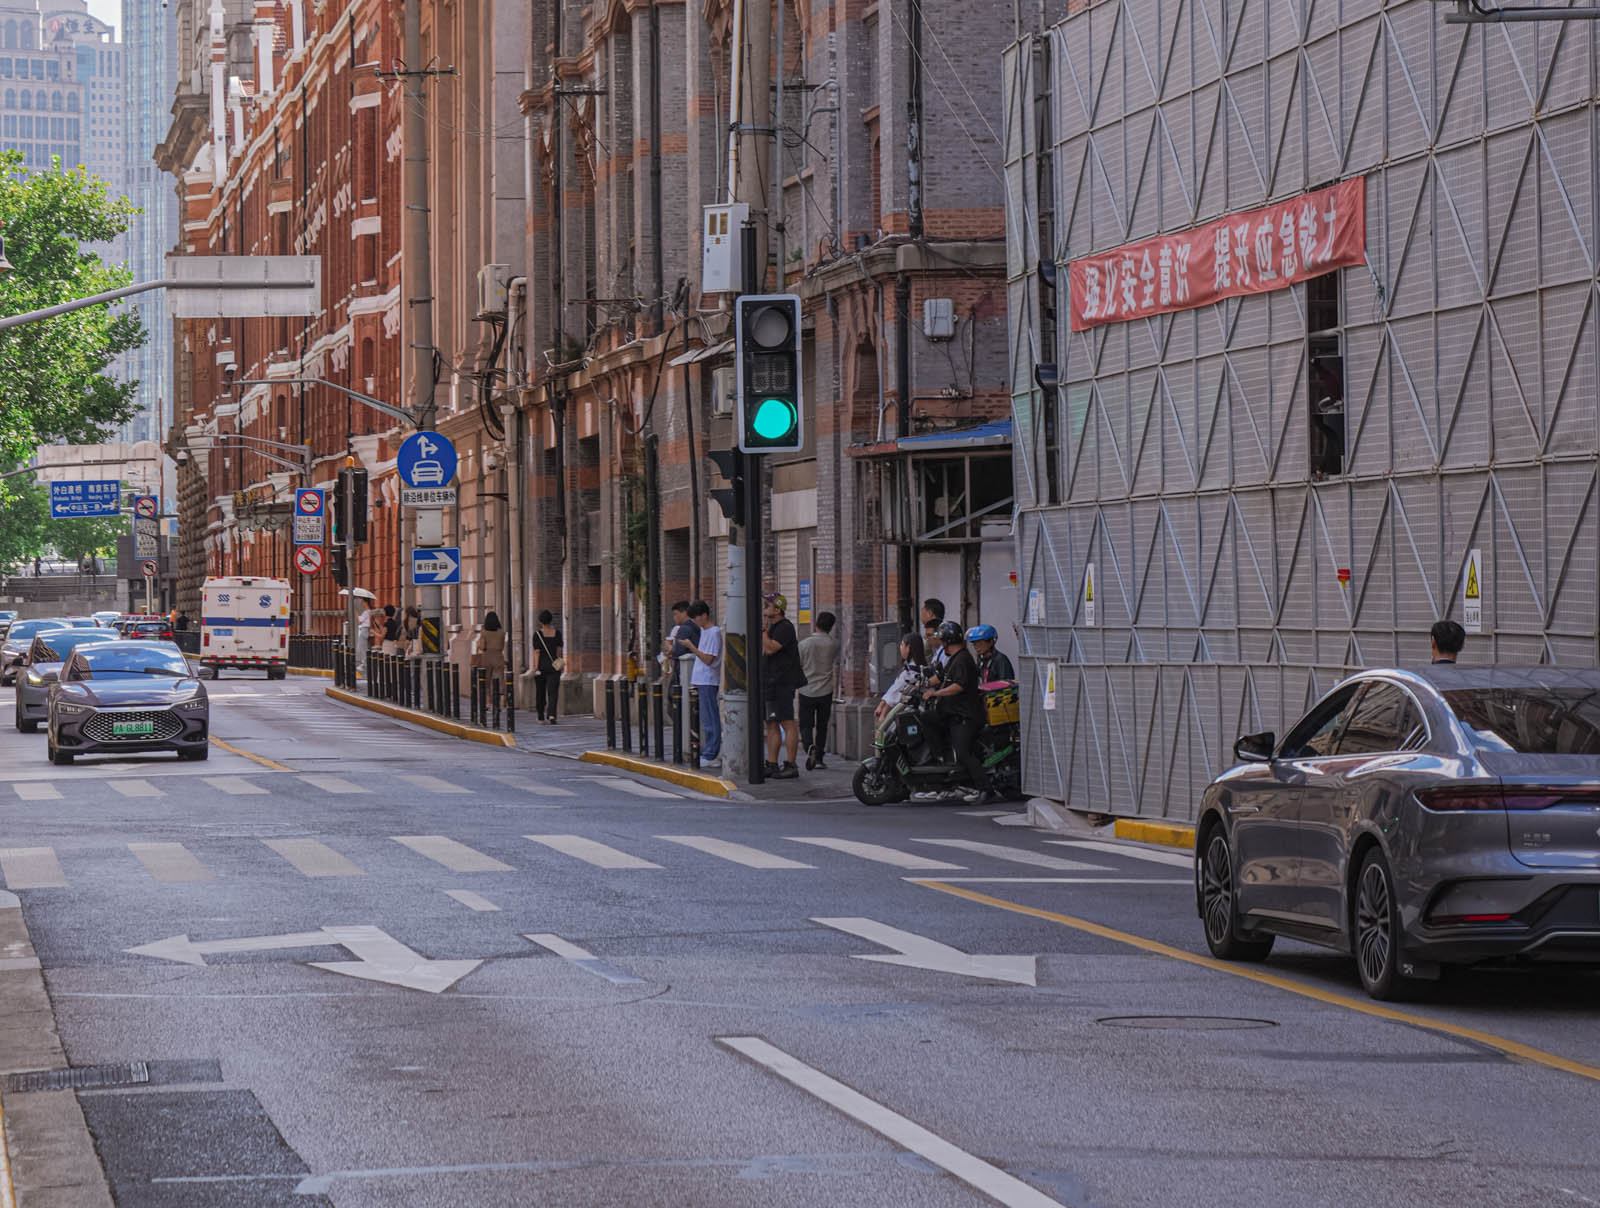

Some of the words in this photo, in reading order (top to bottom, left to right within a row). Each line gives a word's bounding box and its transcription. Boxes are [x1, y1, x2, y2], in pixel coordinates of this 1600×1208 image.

[1082, 243, 1192, 321] 强化安全意识
[1212, 195, 1337, 293] 提升应急能力
[403, 491, 456, 504] 除沿线单位车辆外
[416, 562, 438, 571] 单行道
